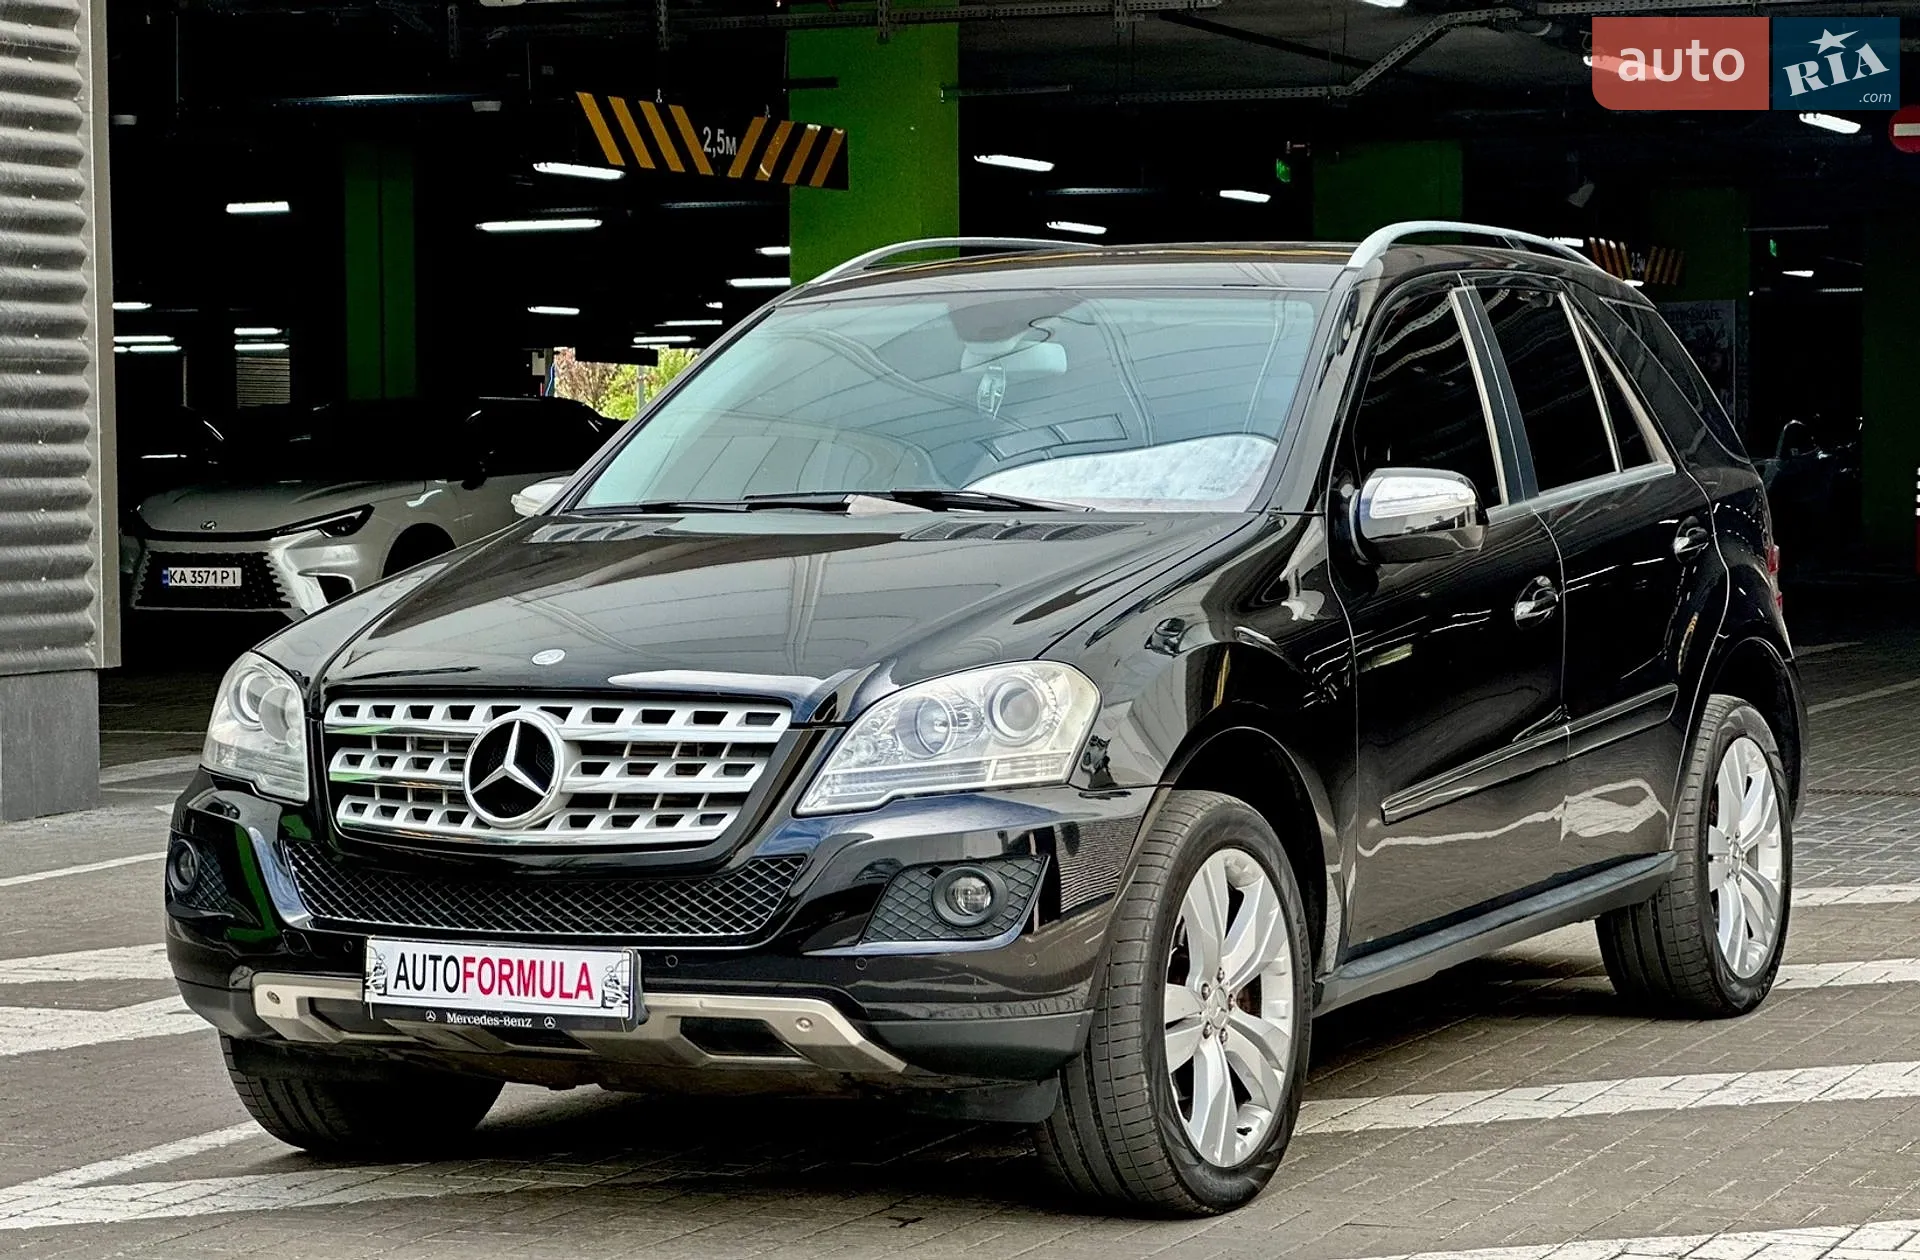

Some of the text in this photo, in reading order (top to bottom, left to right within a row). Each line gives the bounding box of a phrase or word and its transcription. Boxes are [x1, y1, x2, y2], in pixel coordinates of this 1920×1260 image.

[170, 570, 236, 584] KA 3571 PI
[393, 952, 595, 1001] AUTOFORMULA
[446, 1012, 533, 1028] Mercedes-Benz
